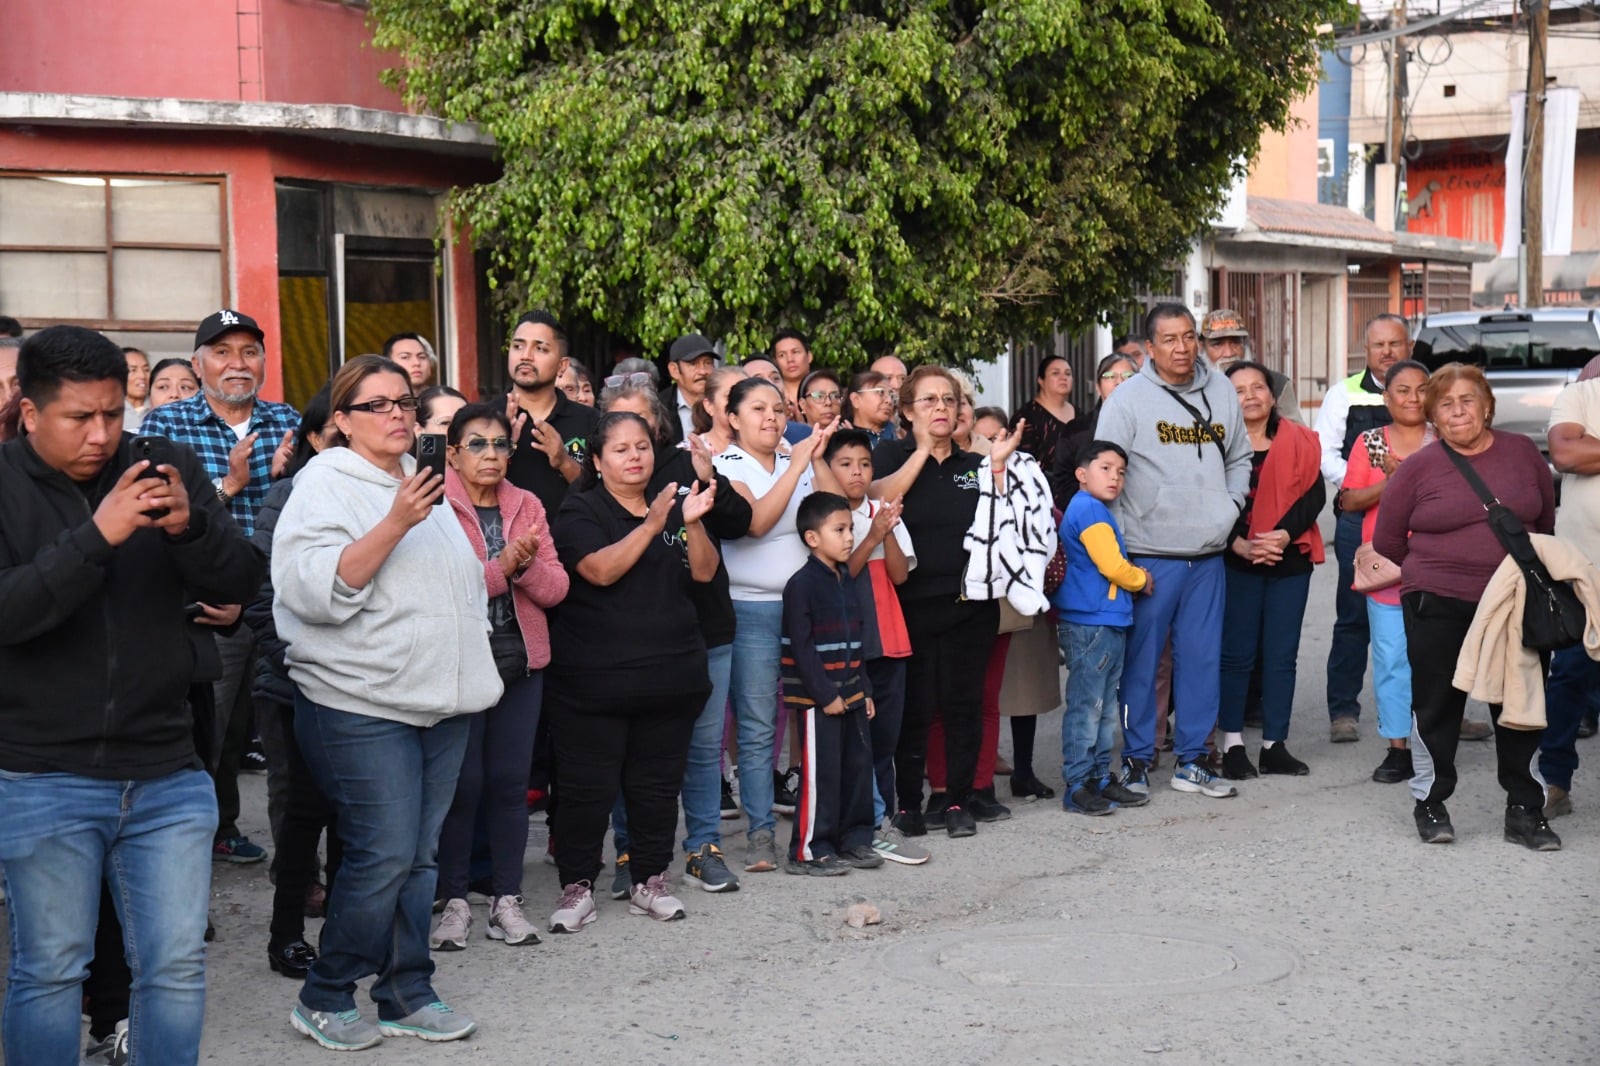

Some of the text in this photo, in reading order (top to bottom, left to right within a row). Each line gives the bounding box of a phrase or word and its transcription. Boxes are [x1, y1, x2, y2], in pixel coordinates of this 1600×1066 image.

[1408, 152, 1493, 171] ERRETERIA
[1504, 288, 1581, 304] FETERIA
[219, 310, 239, 325] LA
[1157, 420, 1226, 444] Steees
